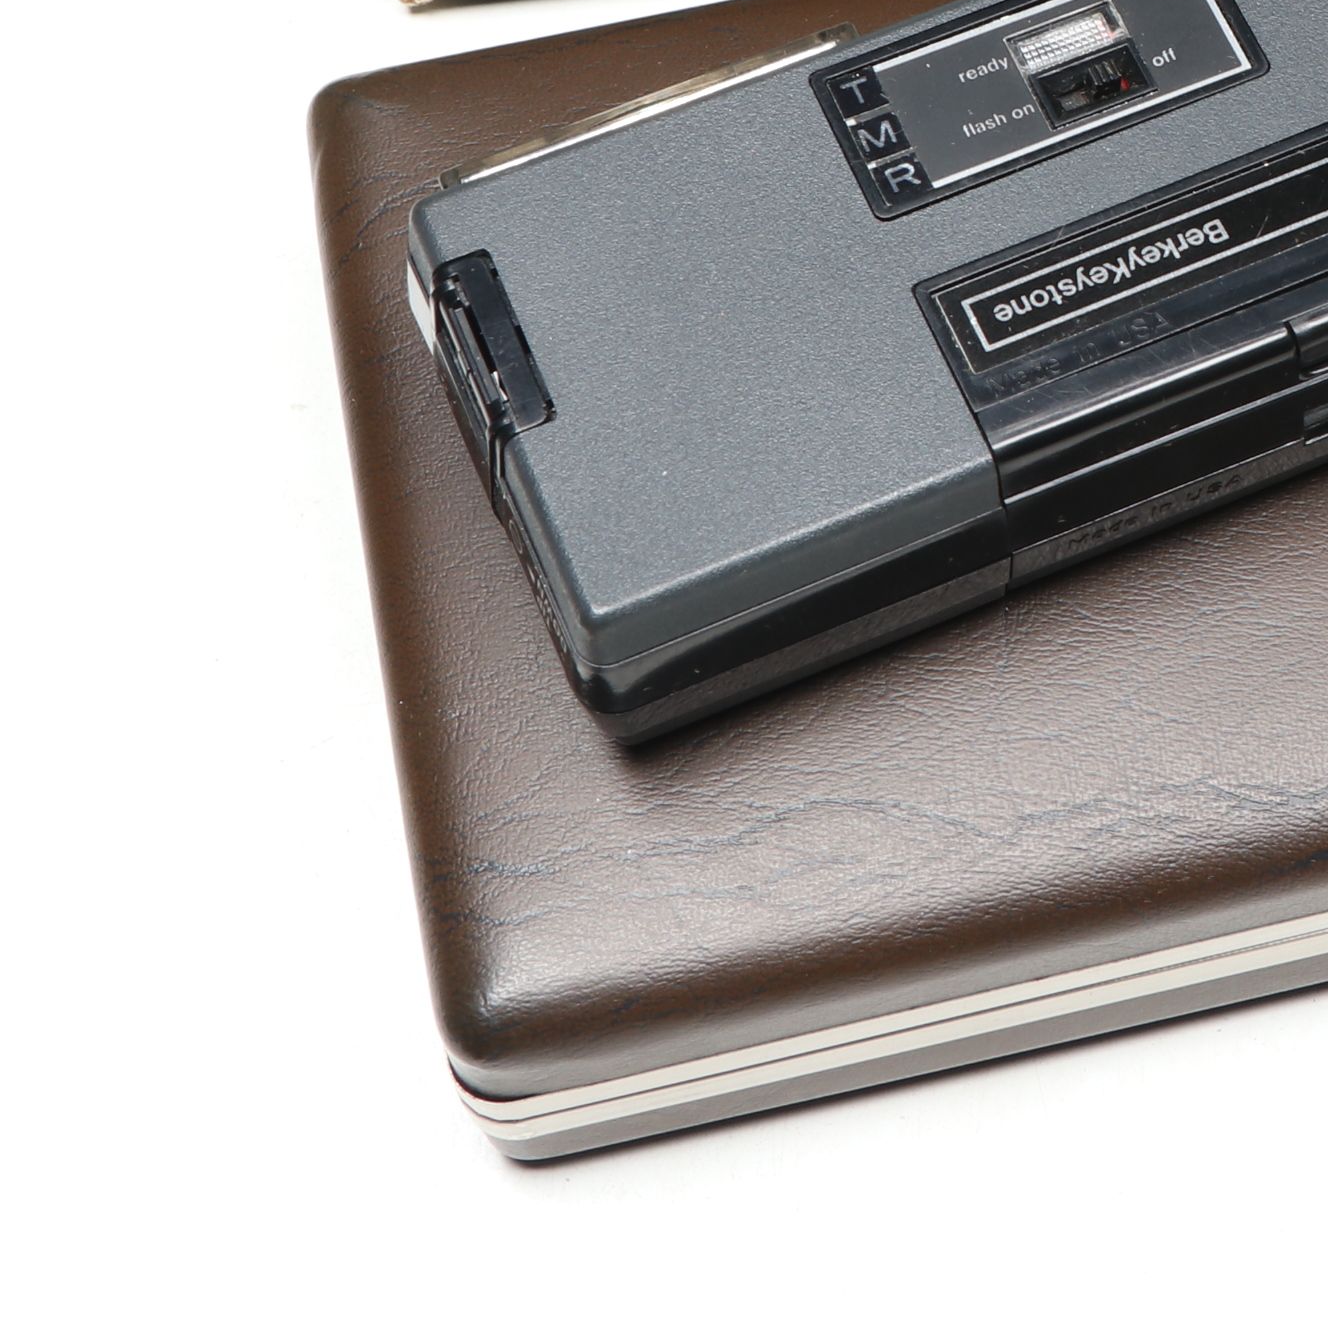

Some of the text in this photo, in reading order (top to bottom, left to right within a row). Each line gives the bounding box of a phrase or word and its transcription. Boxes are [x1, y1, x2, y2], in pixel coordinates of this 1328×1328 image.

[958, 54, 1009, 83] ready
[1152, 47, 1177, 68] off
[839, 77, 869, 104] T
[962, 102, 1036, 139] flash on
[857, 119, 898, 154] M
[884, 162, 922, 193] R
[993, 218, 1231, 322] BerkeyKeystone
